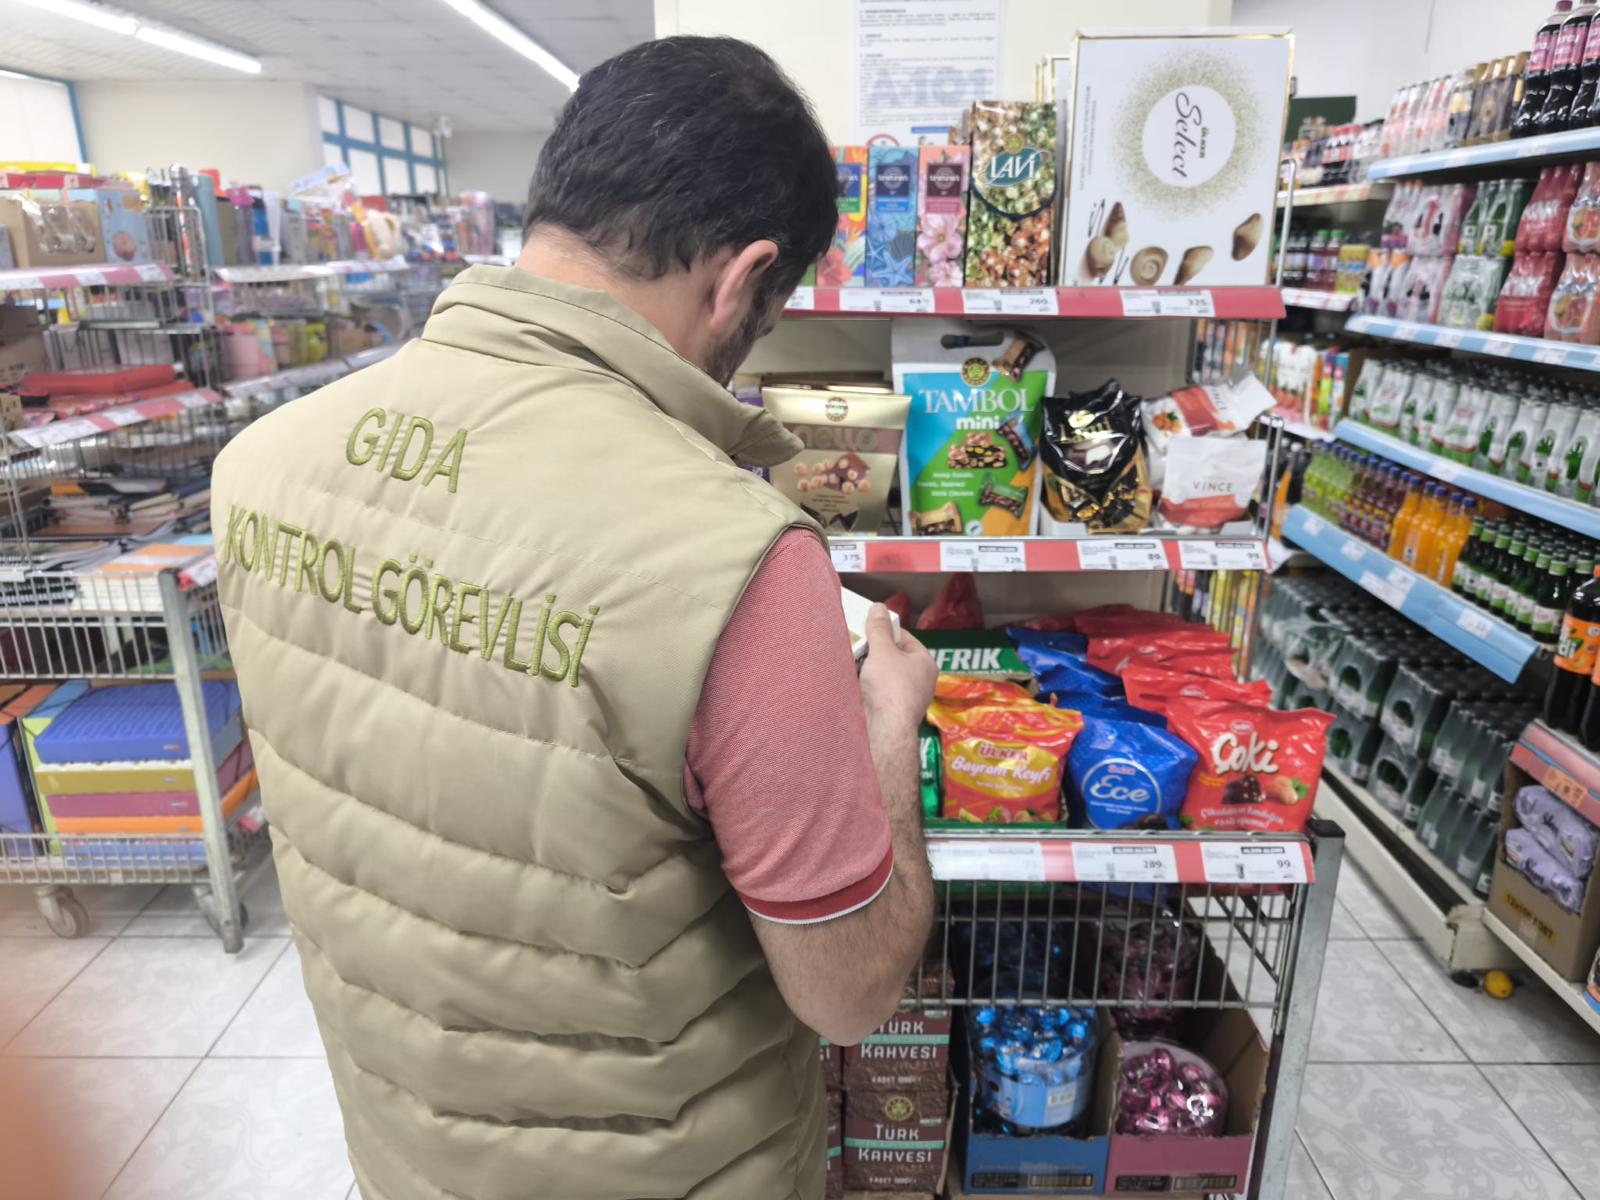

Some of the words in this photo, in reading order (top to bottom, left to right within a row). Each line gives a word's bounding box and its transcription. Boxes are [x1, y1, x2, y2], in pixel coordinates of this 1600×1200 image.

[1172, 92, 1202, 177] Select
[918, 388, 1035, 414] TAMBOL
[956, 415, 1000, 430] mini
[345, 407, 468, 493] GIDA
[1193, 482, 1233, 492] VINCE
[223, 504, 365, 615] KONTROL
[371, 553, 601, 688] GÖREVLİSİ
[1211, 731, 1280, 776] Çoki
[951, 756, 1009, 777] Bayram
[1012, 765, 1053, 785] Keyfi
[1089, 774, 1150, 802] Ece
[1143, 860, 1162, 869] 289
[1277, 860, 1291, 869] 99
